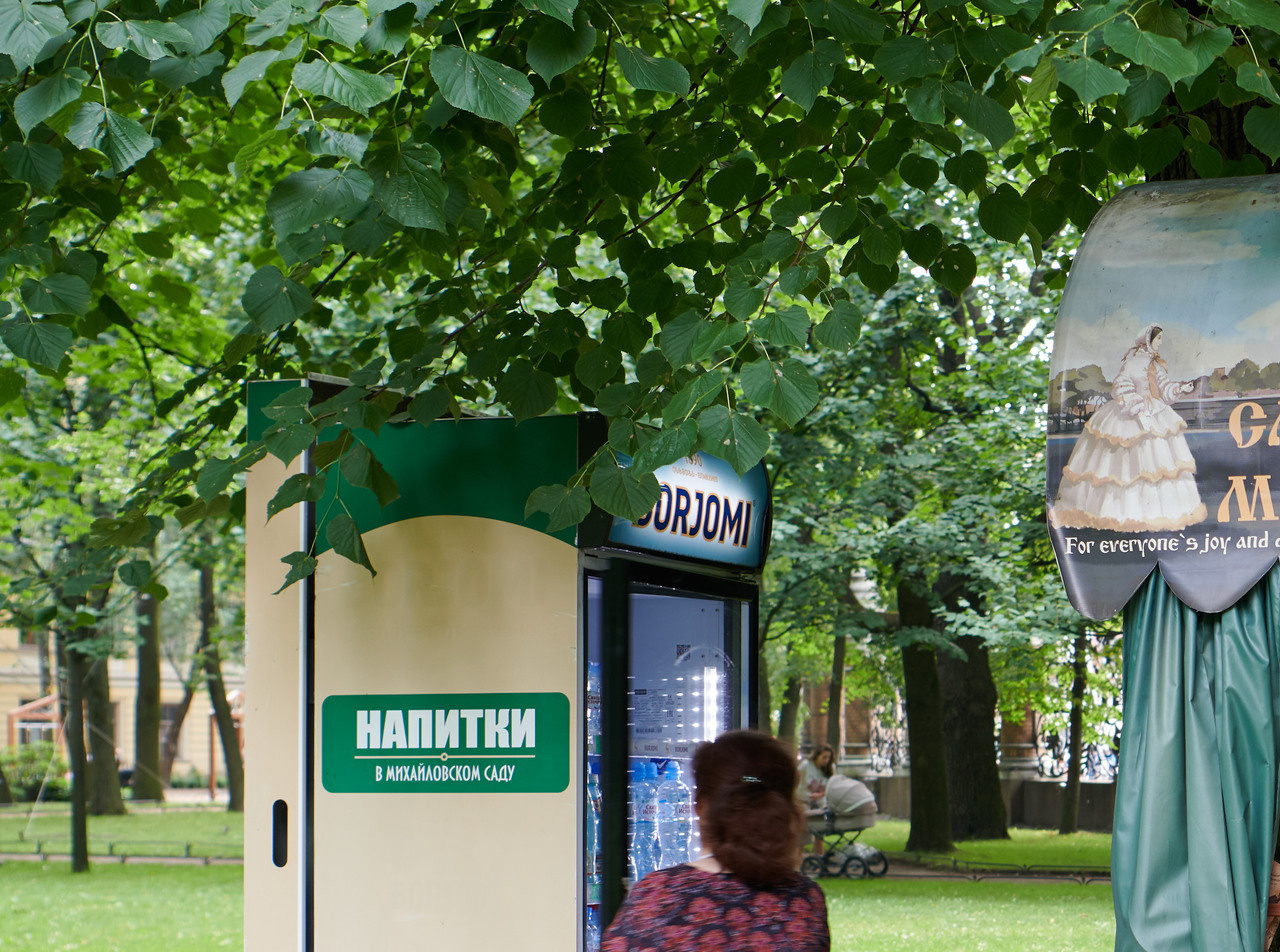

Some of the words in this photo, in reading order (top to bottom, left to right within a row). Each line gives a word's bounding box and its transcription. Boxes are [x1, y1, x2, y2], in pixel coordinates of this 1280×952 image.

[632, 481, 753, 548] ORJOMI
[1065, 537, 1095, 555] For
[1200, 533, 1231, 555] joy
[1236, 531, 1269, 549] and
[356, 708, 536, 749] НАПИТКИ
[375, 765, 383, 781] В
[386, 763, 481, 781] МИХАЙЛОВСКОМ
[484, 765, 515, 782] САДУ
